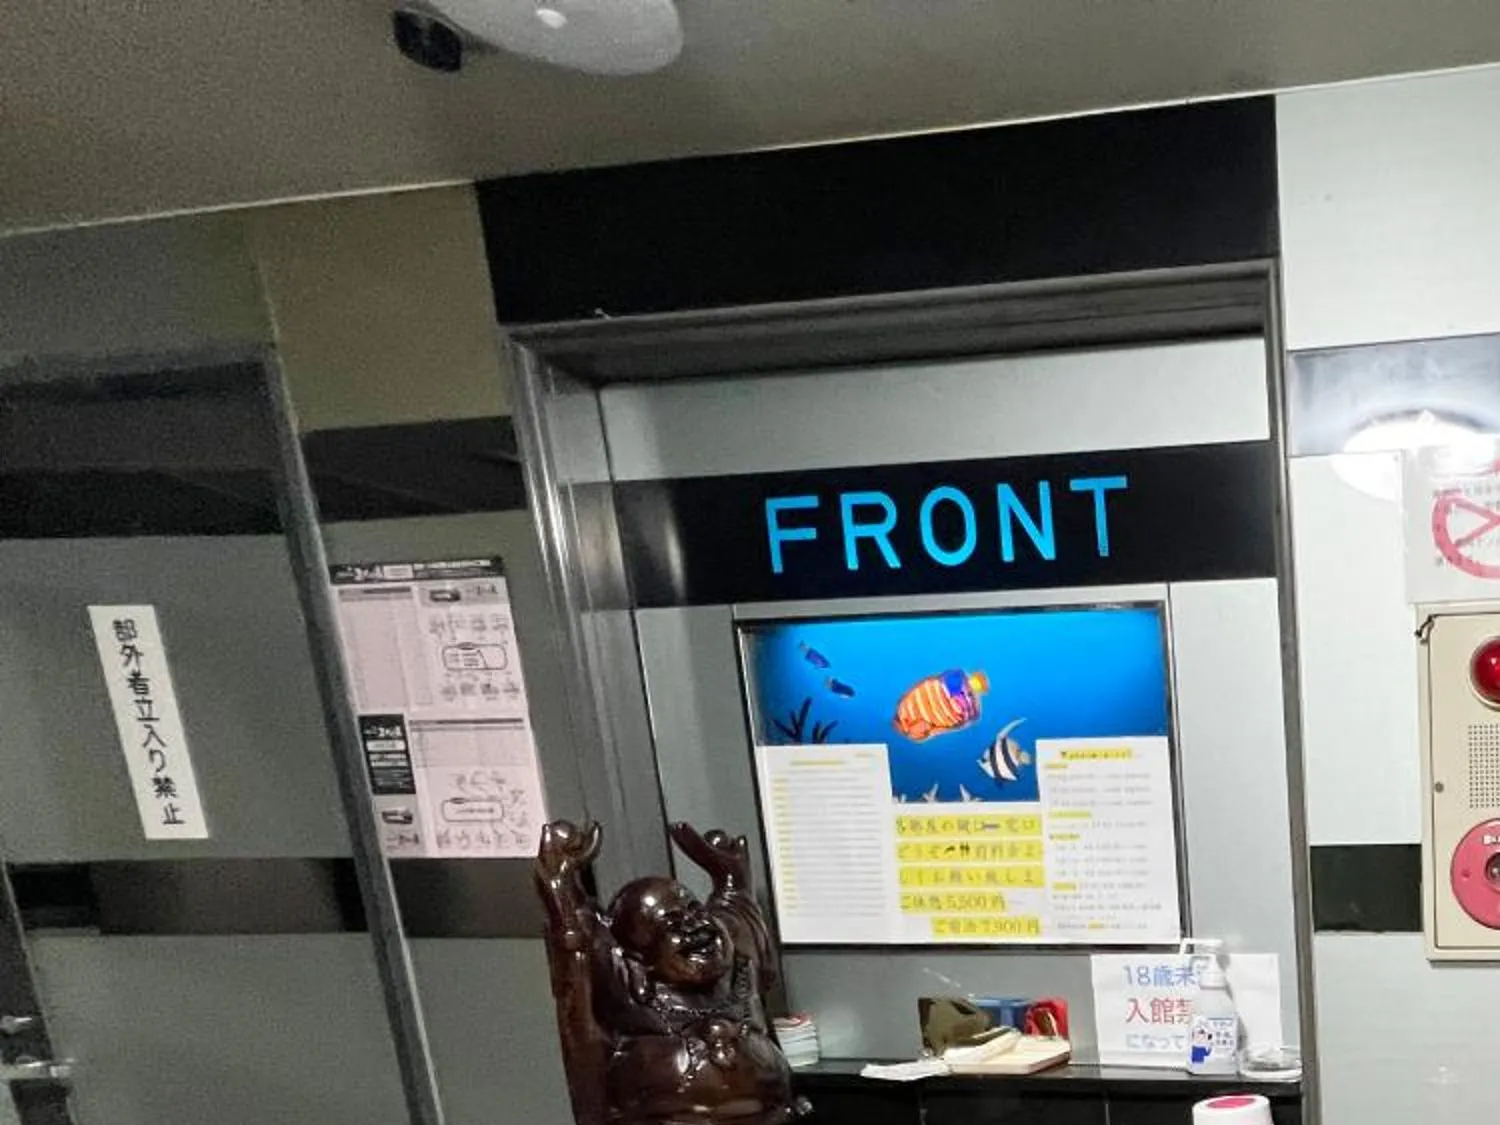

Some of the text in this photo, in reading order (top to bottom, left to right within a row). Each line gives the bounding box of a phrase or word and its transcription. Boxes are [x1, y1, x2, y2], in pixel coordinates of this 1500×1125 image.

[765, 475, 1128, 574] FRONT
[112, 618, 185, 825] 部外者立入り禁止
